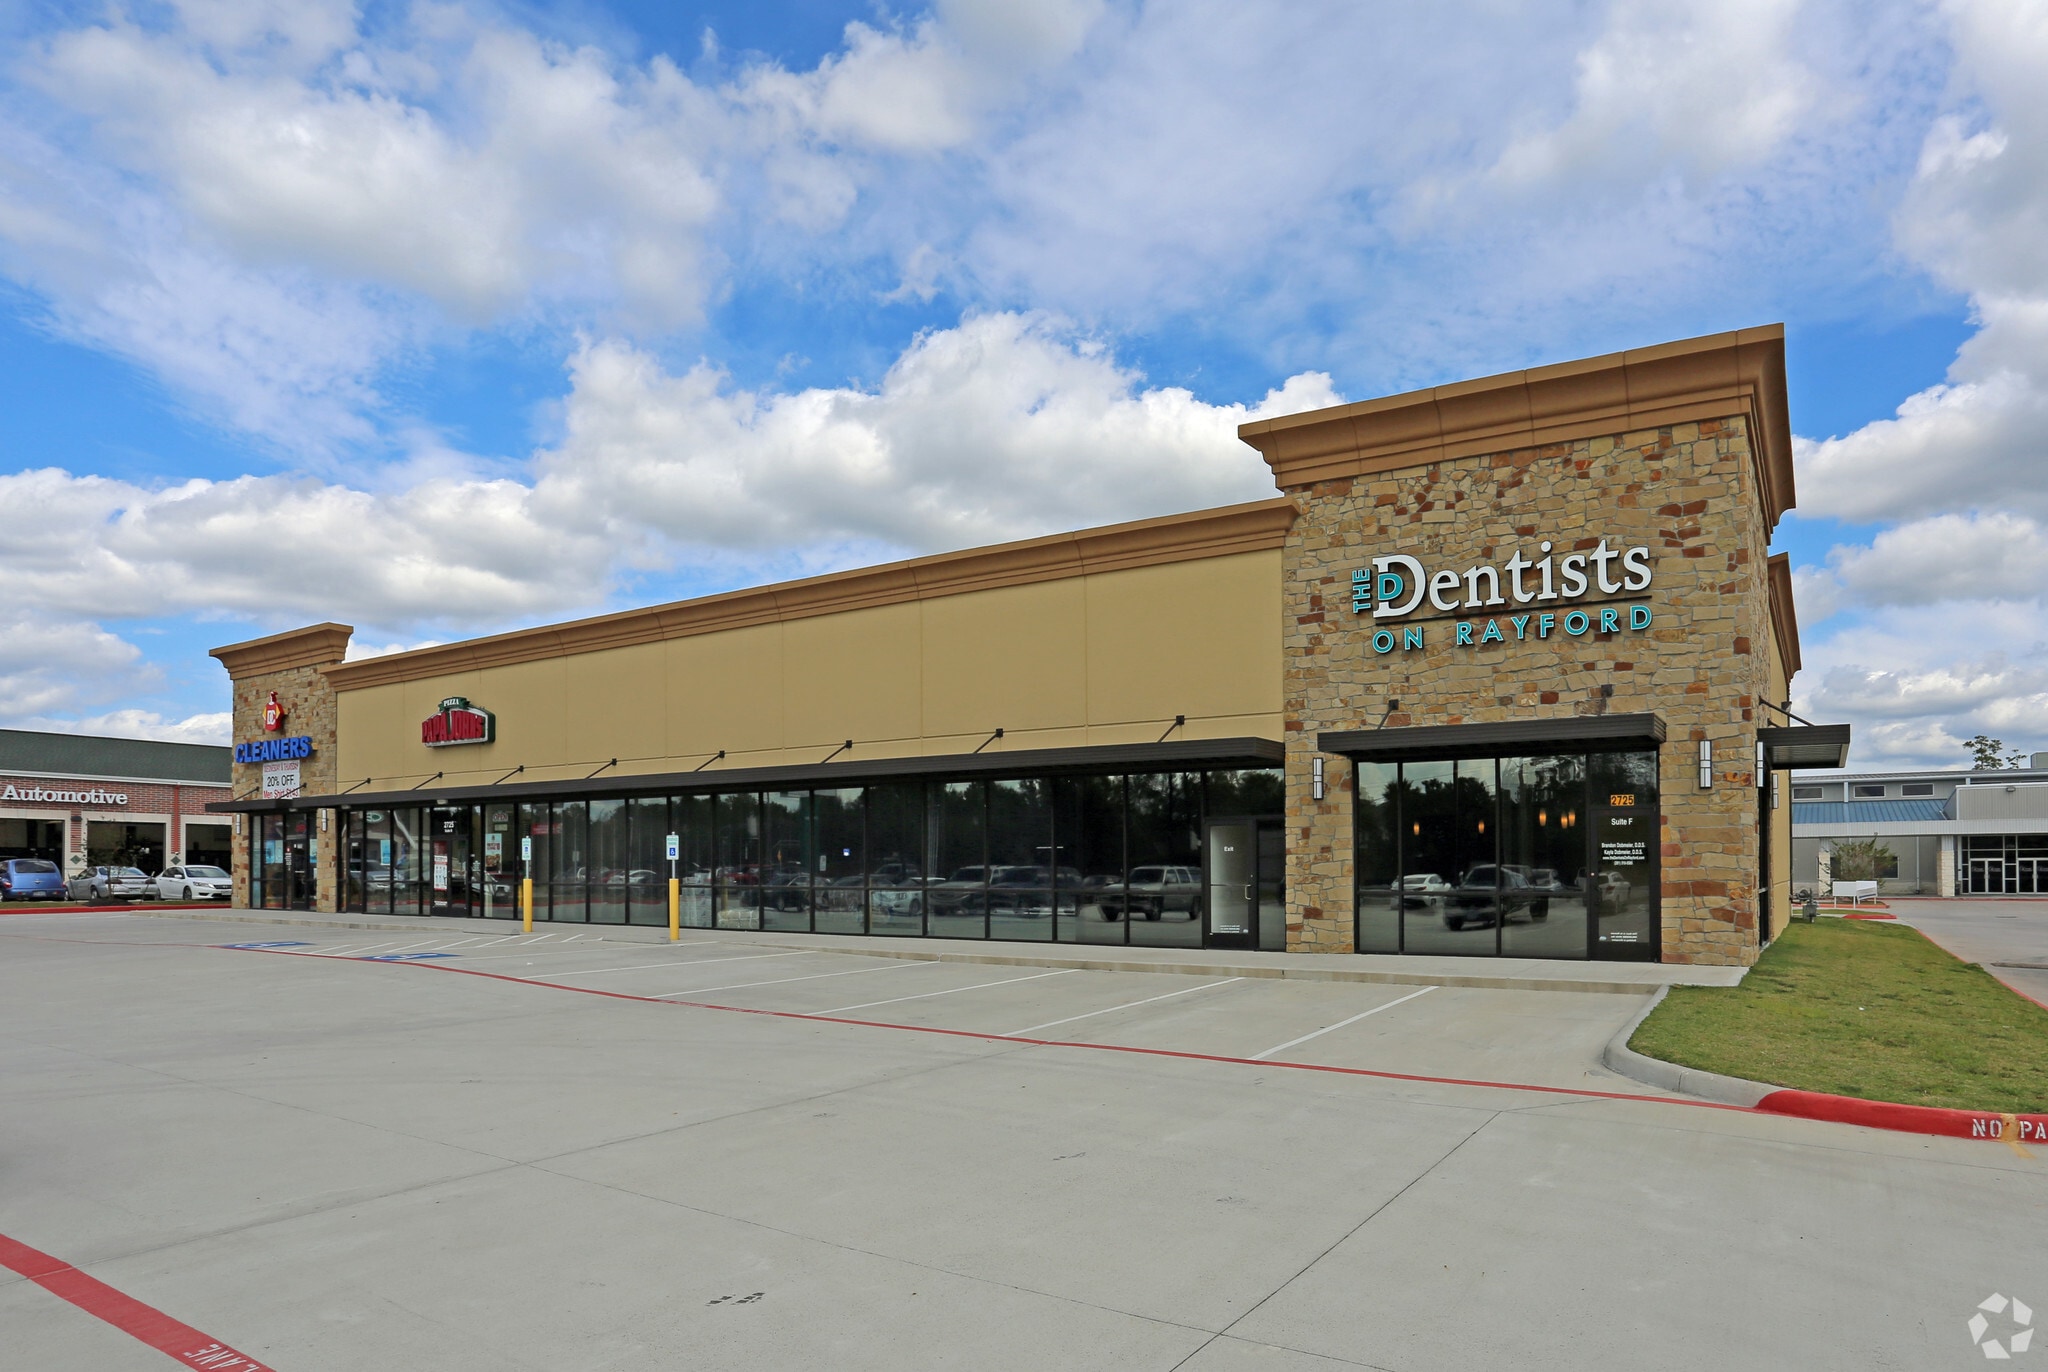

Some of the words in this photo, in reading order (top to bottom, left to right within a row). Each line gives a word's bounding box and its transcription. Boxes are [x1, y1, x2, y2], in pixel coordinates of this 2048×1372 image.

[1372, 539, 1652, 619] Dentists
[1352, 568, 1371, 614] THE
[1372, 626, 1424, 654] ON
[1456, 605, 1653, 646] RAYFORD
[443, 698, 460, 706] PIZZA
[422, 711, 448, 743] PAPA
[235, 736, 313, 764] CLEANERS
[267, 776, 280, 787] 20%
[0, 784, 128, 805] Automotive
[1611, 795, 1634, 806] 2725
[1611, 818, 1628, 826] Suite
[1972, 1118, 2003, 1138] NO
[2020, 1120, 2047, 1139] PA
